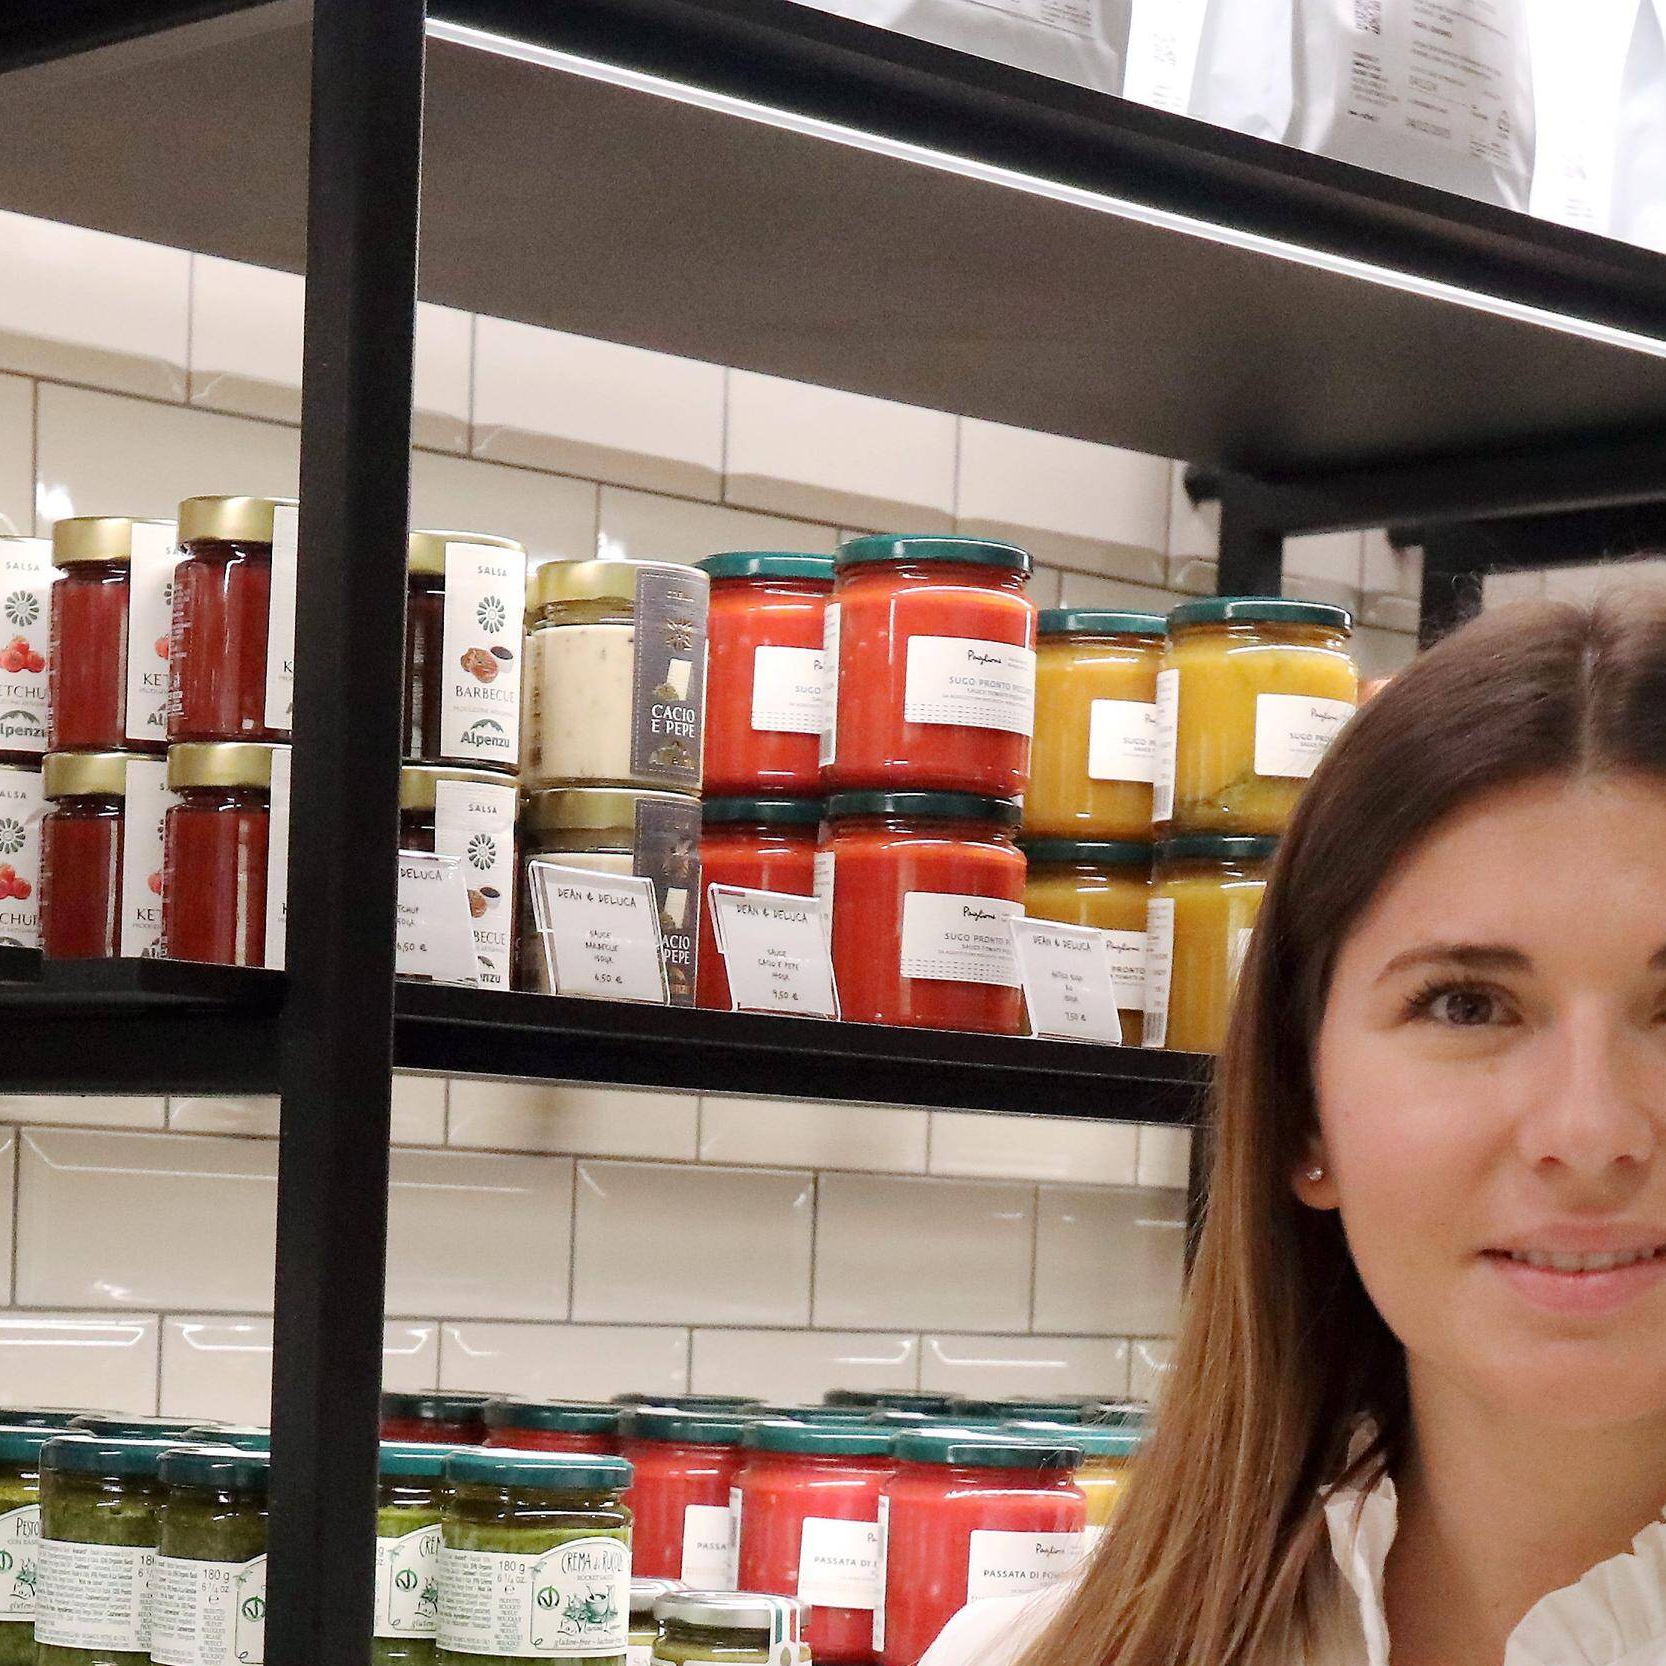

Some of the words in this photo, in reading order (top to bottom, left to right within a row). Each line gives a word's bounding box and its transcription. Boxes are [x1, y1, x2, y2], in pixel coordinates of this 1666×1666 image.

[5, 561, 40, 572] SALSA
[477, 565, 508, 577] SALSA
[949, 675, 976, 687] SUGO
[455, 685, 514, 703] BARBECUE
[651, 704, 695, 722] CACIO
[650, 719, 660, 733] E
[665, 721, 695, 738] PEPE
[460, 730, 510, 748] Alpenzu
[468, 803, 498, 814] SALSA
[558, 887, 583, 900] DEAN
[598, 893, 637, 909] DELUCA
[736, 904, 760, 917] DEAN
[773, 909, 809, 924] DELUCA
[944, 931, 970, 943] SUGO
[973, 934, 1004, 945] PRONTO
[498, 1560, 516, 1572] 180
[814, 1556, 856, 1567] PASSATA
[203, 1569, 221, 1581] 180
[983, 1568, 1026, 1579] PASSATA
[1029, 1570, 1039, 1580] DI
